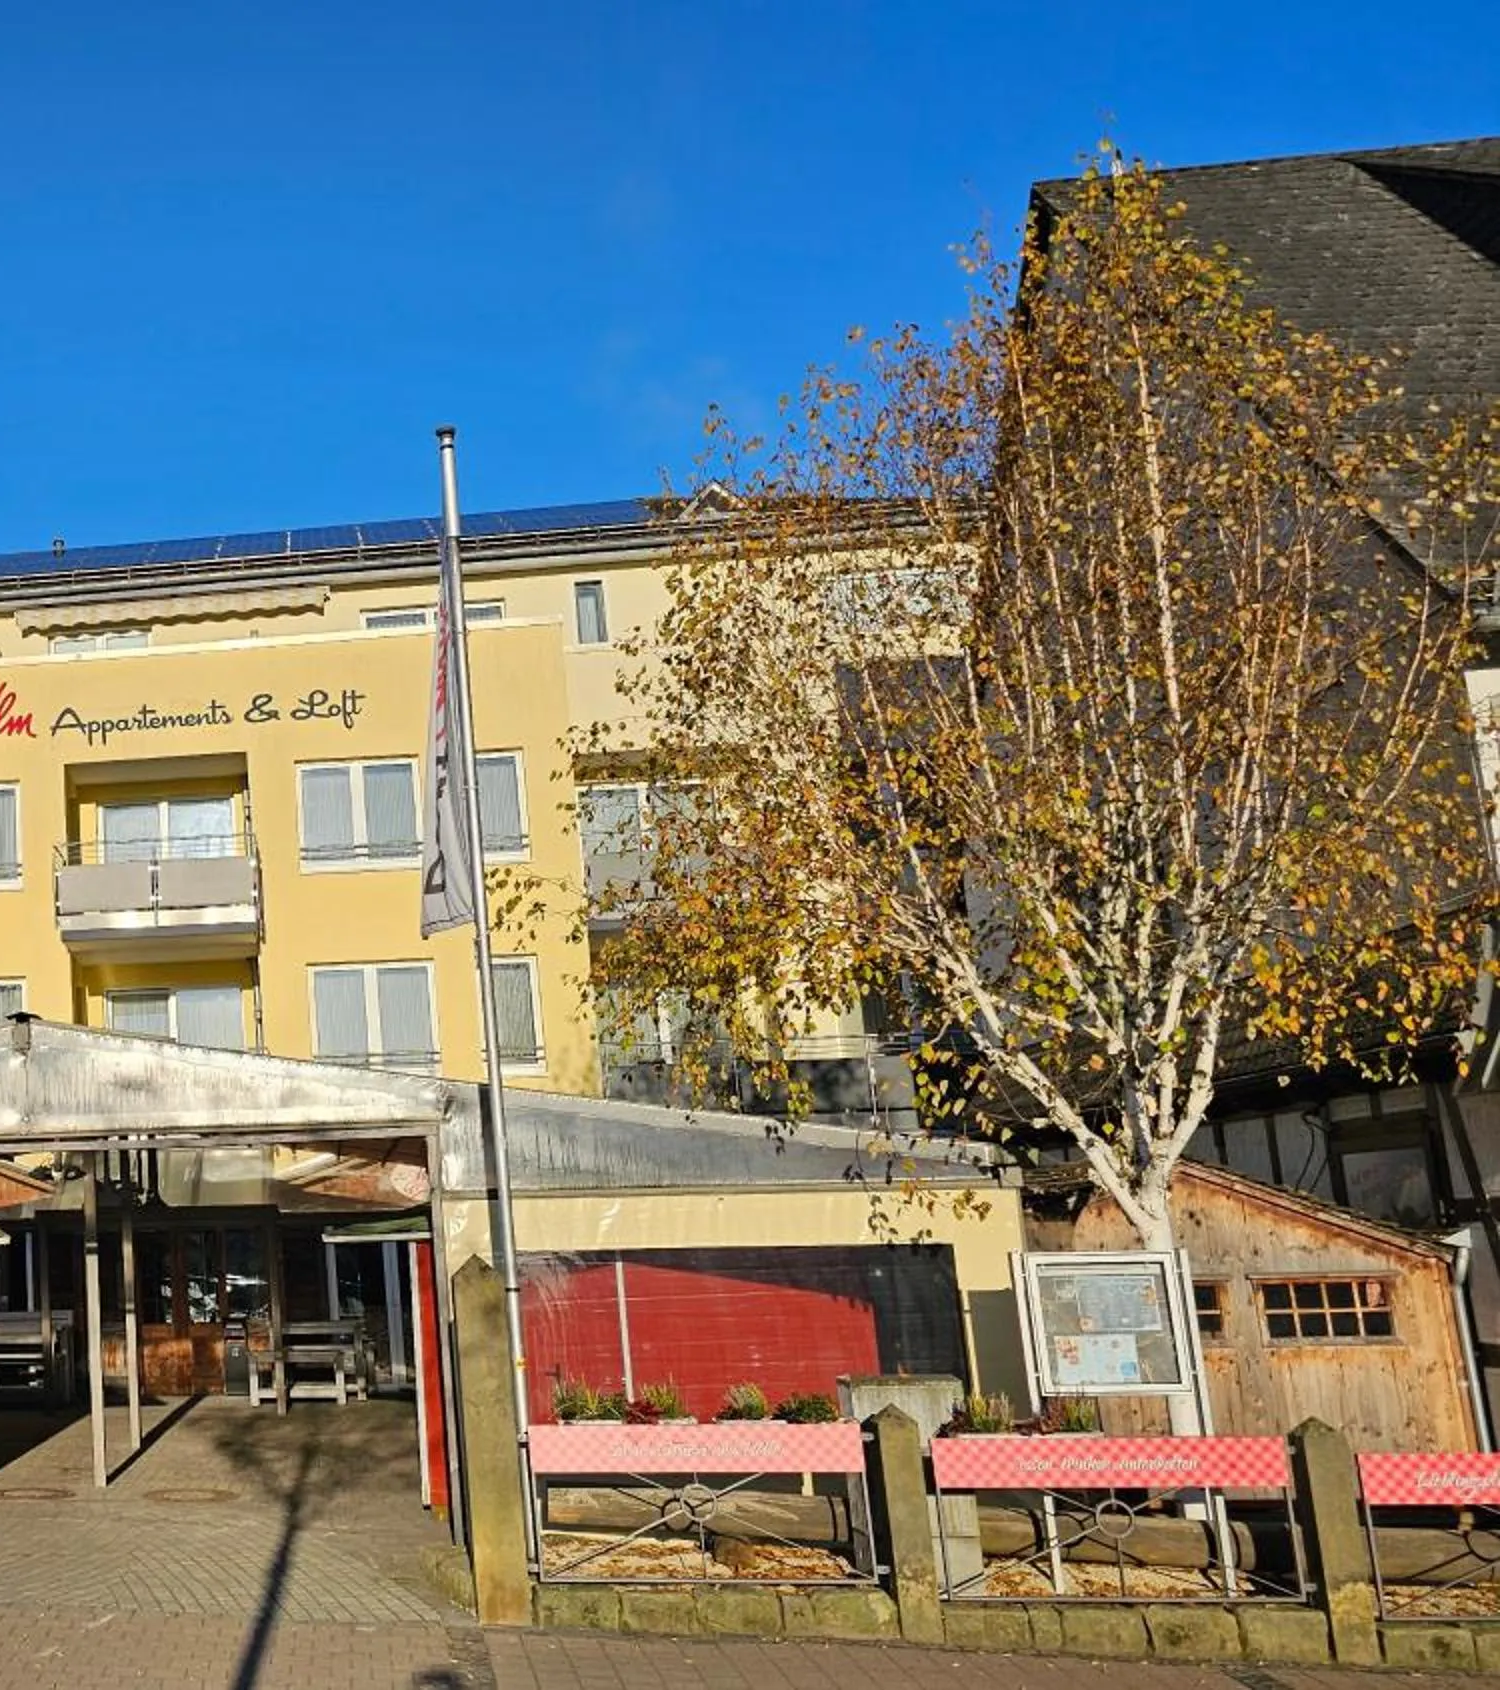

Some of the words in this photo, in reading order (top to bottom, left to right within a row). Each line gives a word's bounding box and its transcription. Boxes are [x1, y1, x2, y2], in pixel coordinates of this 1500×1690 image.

[50, 700, 232, 747] Appartements
[244, 693, 280, 723] &
[289, 689, 366, 729] Loft
